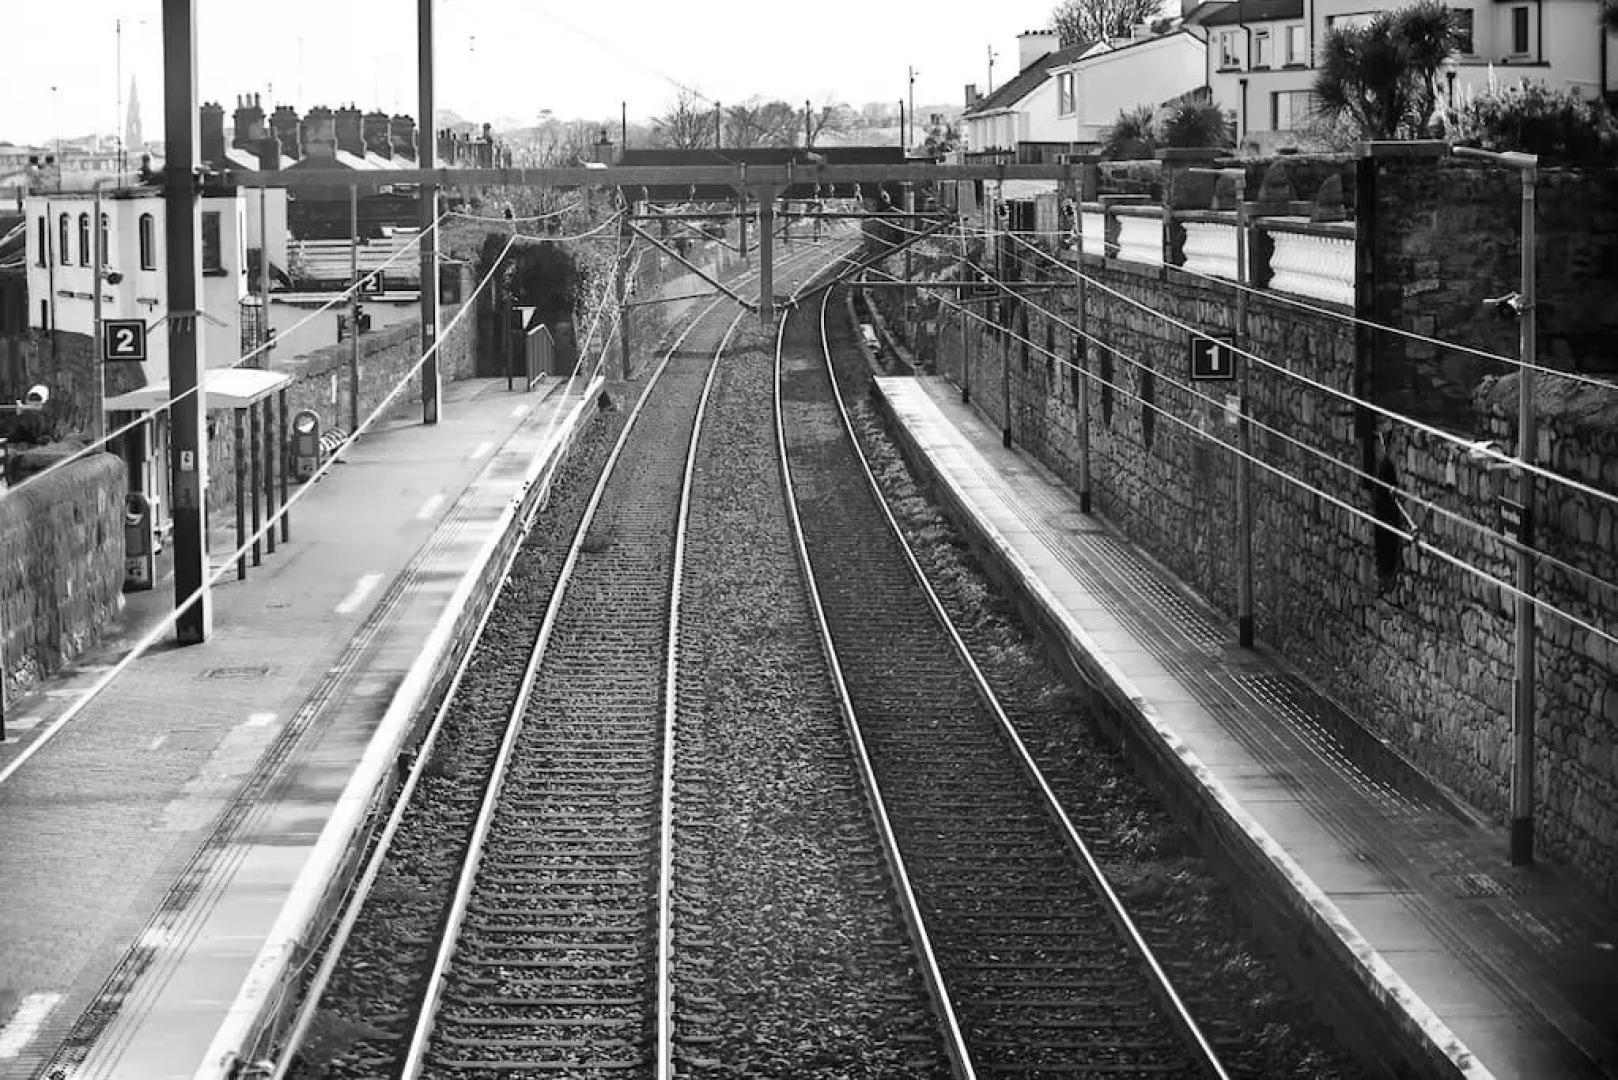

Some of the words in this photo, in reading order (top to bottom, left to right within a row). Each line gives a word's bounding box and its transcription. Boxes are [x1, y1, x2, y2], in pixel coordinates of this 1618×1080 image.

[366, 274, 377, 290] 2
[116, 328, 134, 352] 2
[1205, 344, 1219, 371] 1
